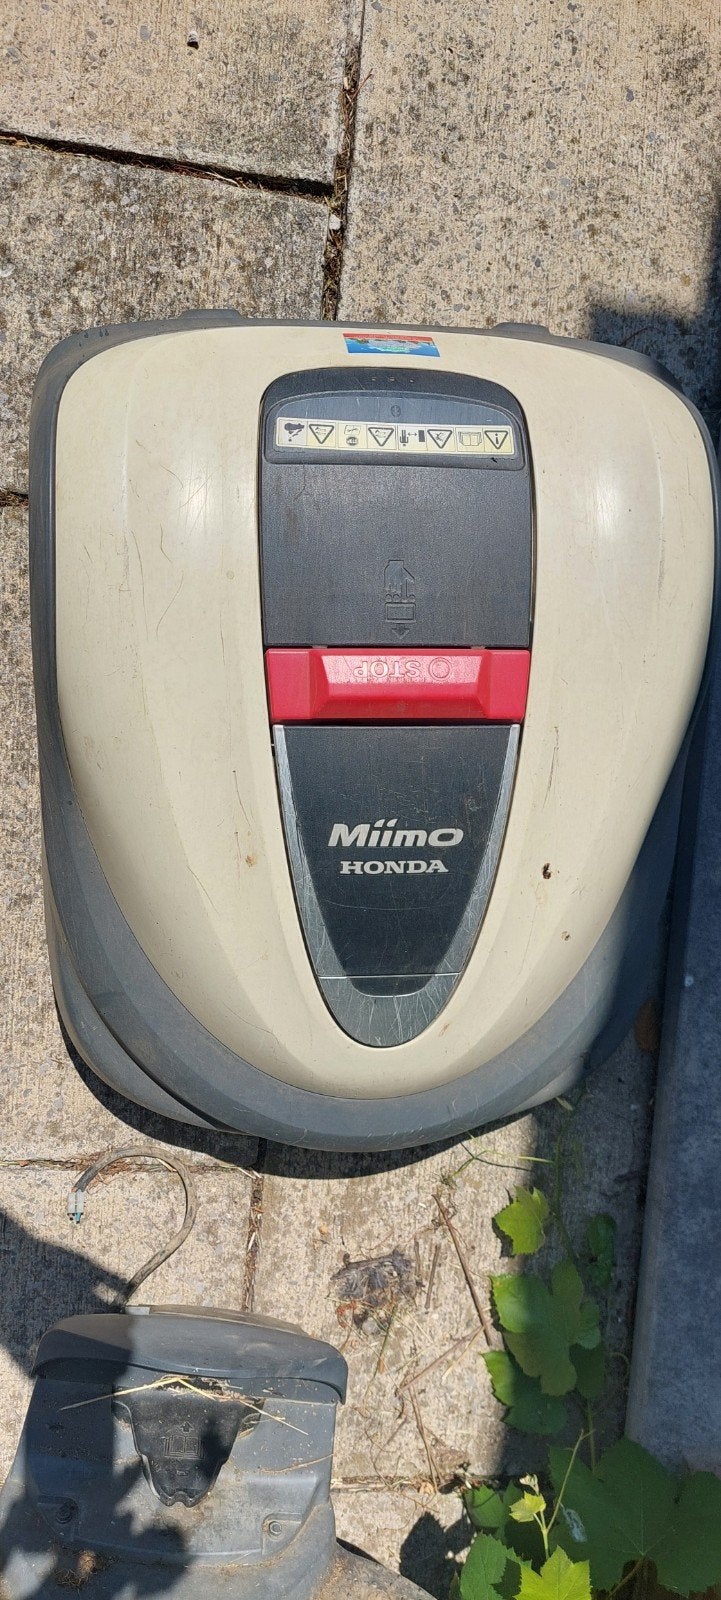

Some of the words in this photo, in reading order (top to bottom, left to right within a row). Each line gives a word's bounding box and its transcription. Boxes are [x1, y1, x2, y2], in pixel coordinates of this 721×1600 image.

[353, 661, 421, 678] STOP
[328, 818, 464, 847] Miimo
[340, 859, 449, 875] HONDA
